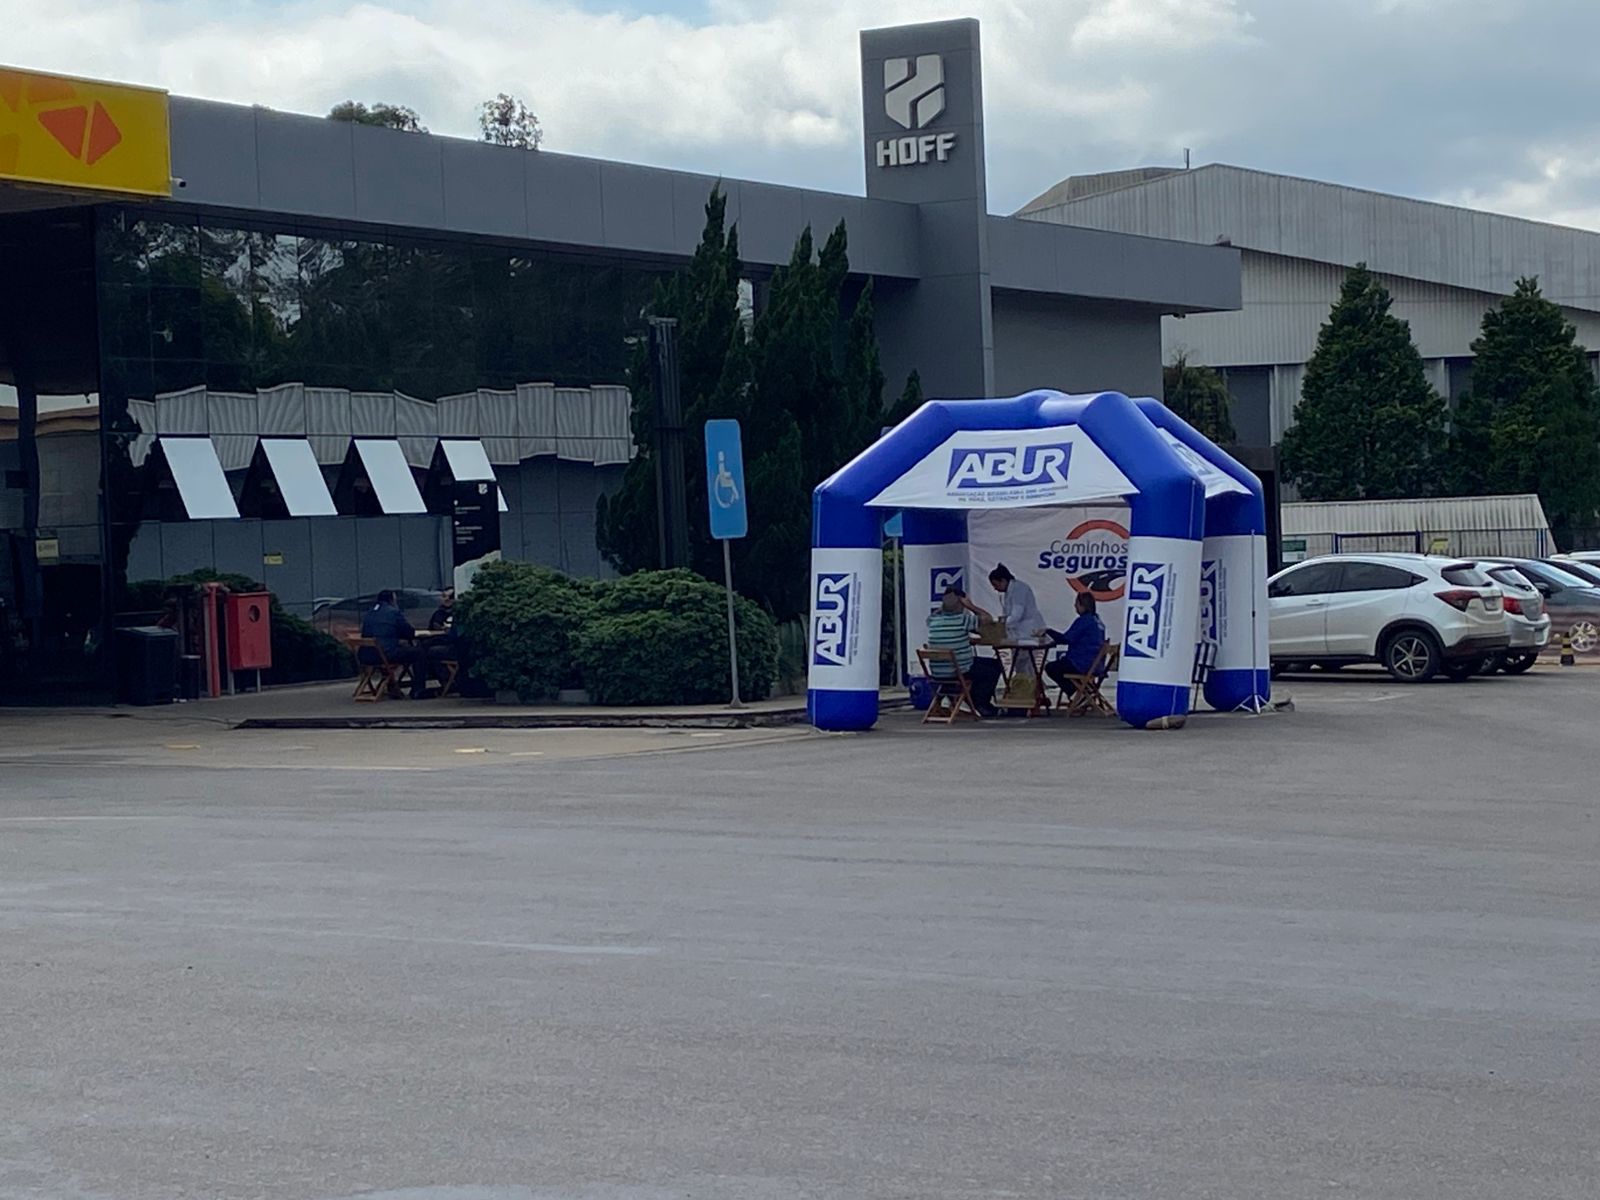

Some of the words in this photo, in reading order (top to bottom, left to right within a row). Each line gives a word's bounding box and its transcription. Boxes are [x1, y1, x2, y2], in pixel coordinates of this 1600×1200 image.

[876, 132, 957, 167] HOFF
[946, 443, 1071, 489] ABUR
[1038, 551, 1128, 574] Seguros
[1050, 540, 1128, 554] Caminhos
[815, 573, 850, 666] ABUR
[1127, 563, 1165, 659] ABUR
